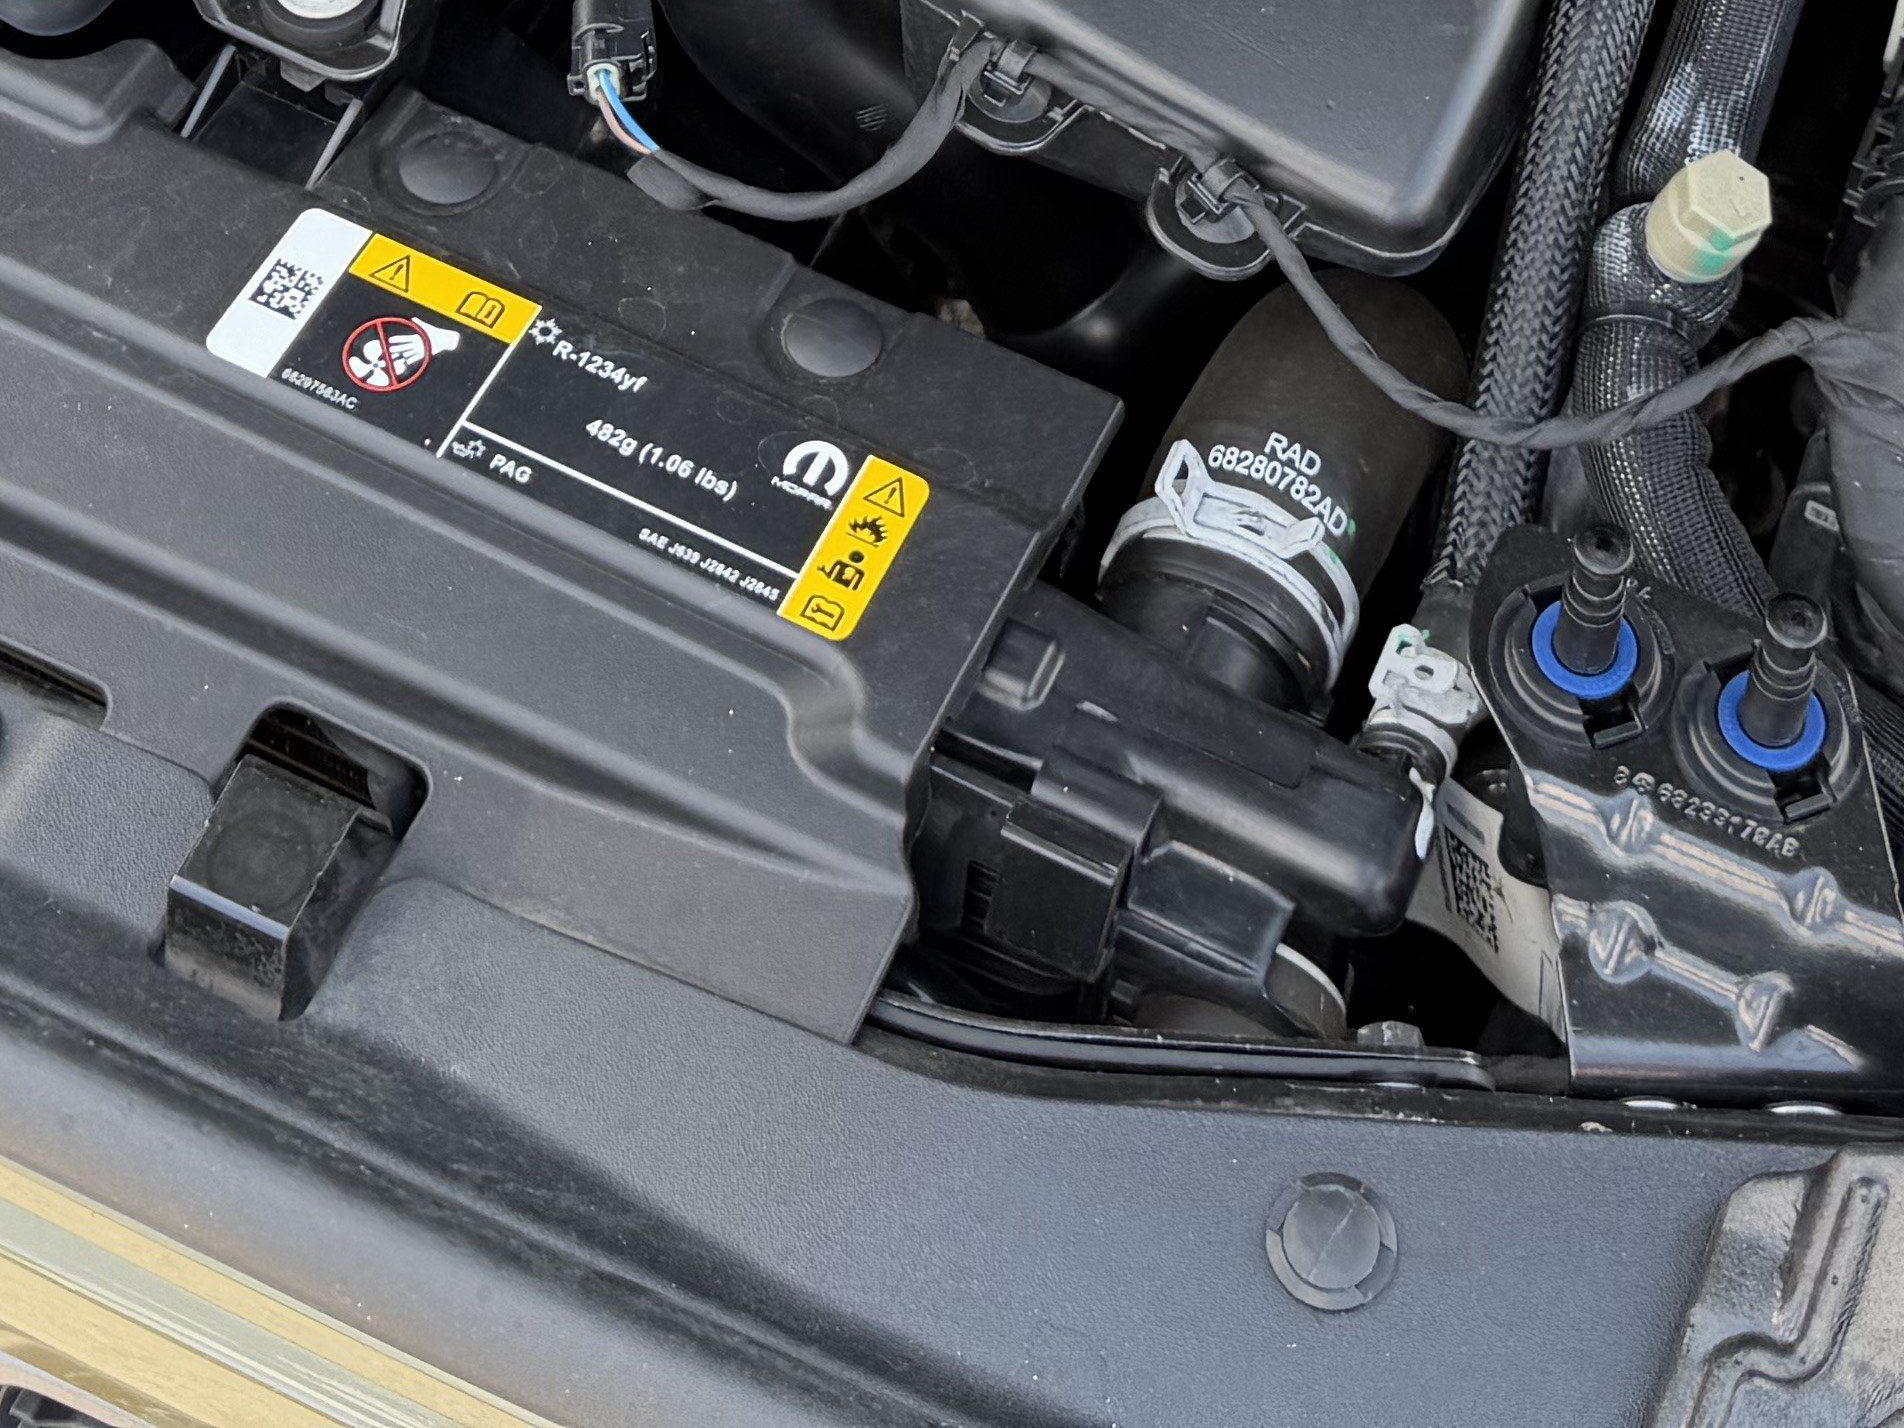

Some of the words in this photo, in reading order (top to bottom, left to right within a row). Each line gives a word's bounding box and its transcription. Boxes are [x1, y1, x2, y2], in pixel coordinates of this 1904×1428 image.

[552, 340, 648, 393] R-1234yf
[489, 453, 532, 484] PAG
[585, 419, 638, 457] 482g
[639, 442, 694, 480] (1.06
[694, 467, 737, 502] lbs)
[1264, 432, 1322, 476] RAD
[1208, 444, 1348, 537] 68280782AD
[638, 527, 669, 551] SAE
